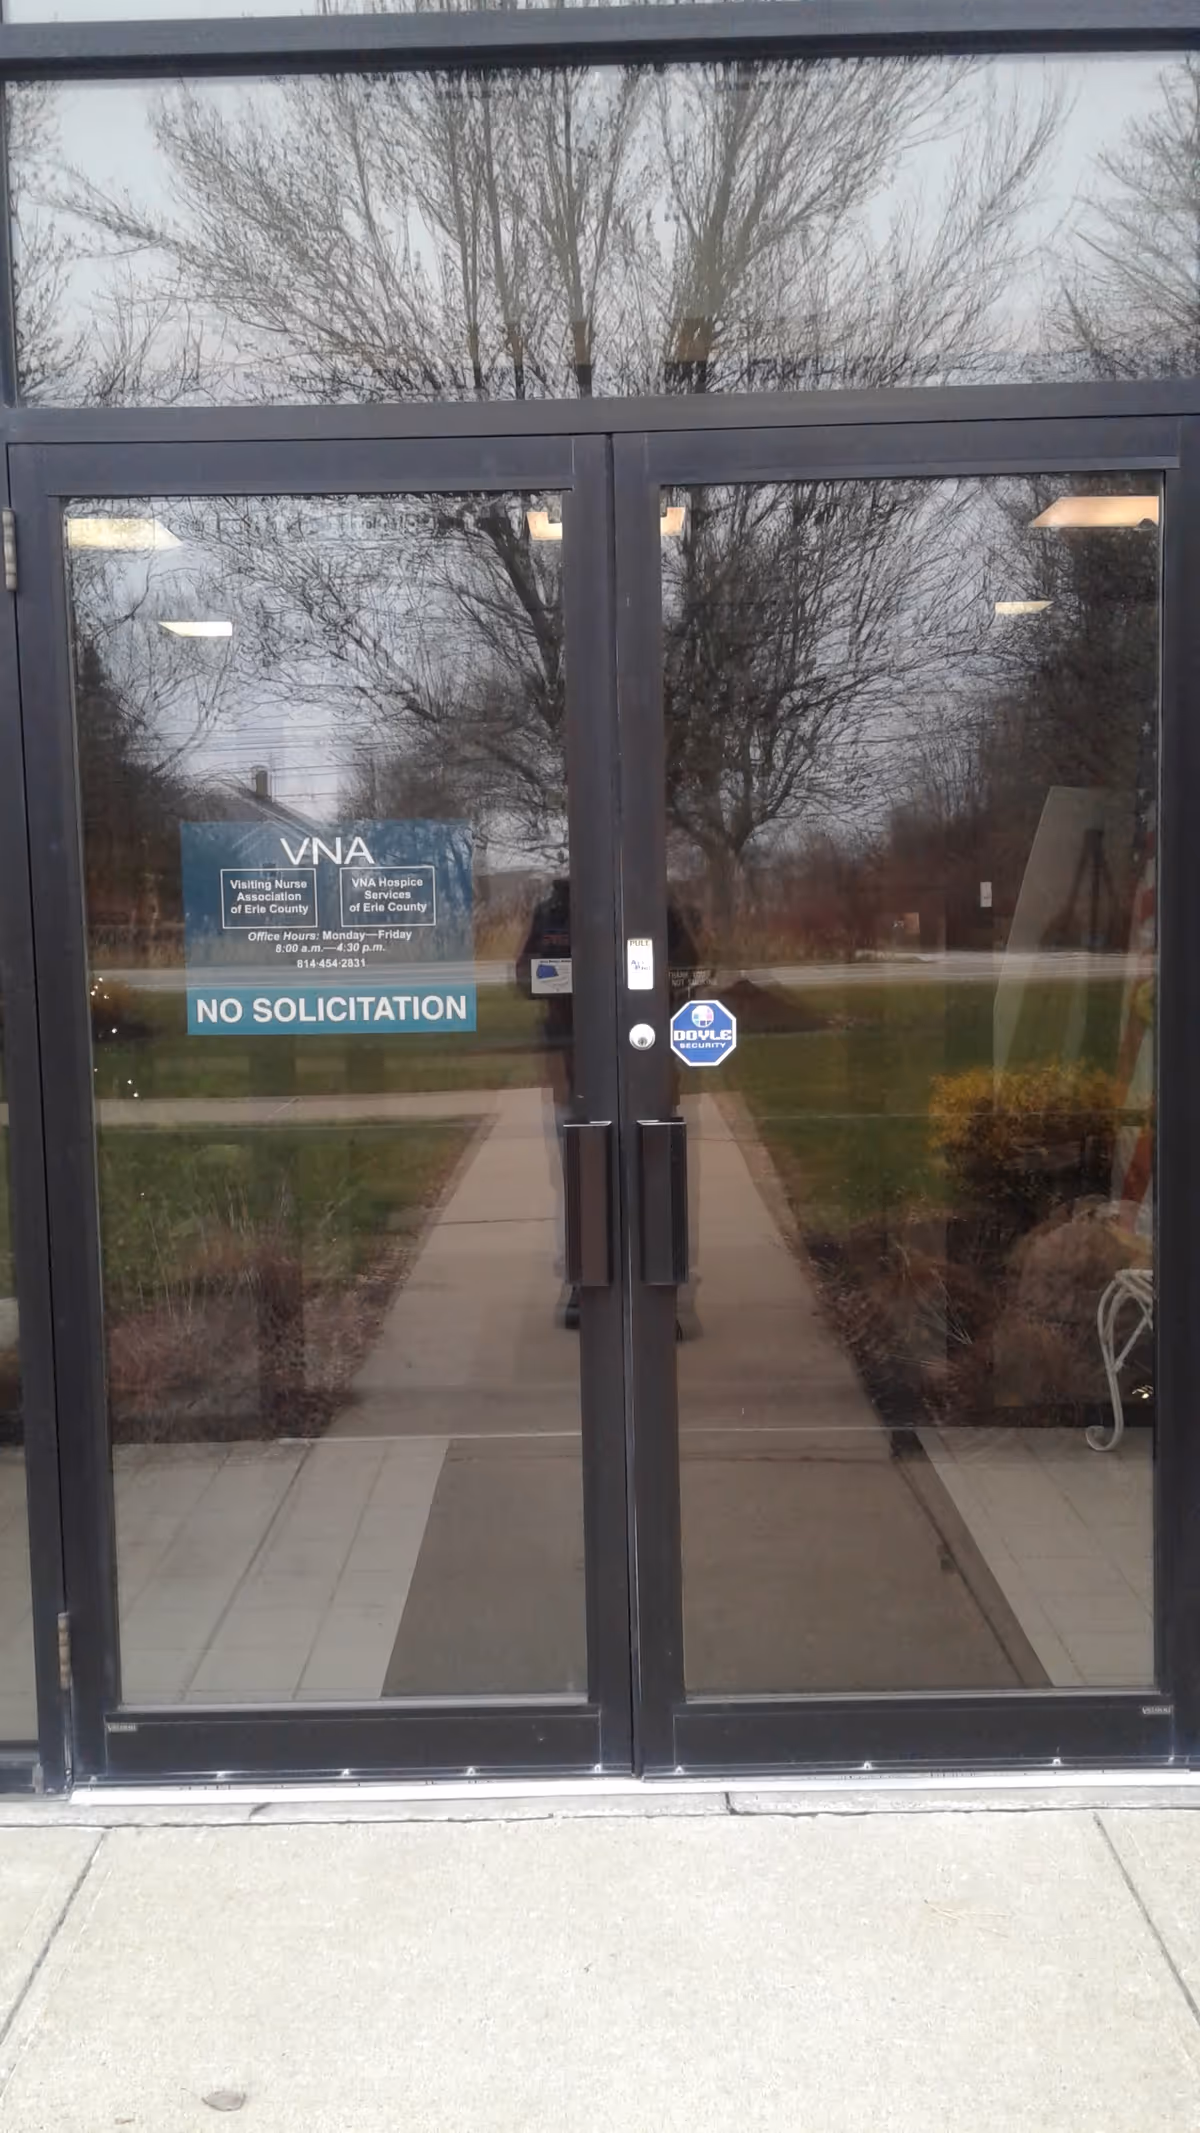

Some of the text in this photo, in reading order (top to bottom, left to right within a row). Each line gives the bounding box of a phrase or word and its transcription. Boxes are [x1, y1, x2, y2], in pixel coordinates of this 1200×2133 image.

[280, 836, 375, 866] VNA
[230, 880, 308, 891] Visiting Nurse
[351, 877, 424, 888] VNA Hospice
[236, 892, 302, 902] Association
[364, 890, 412, 900] Services
[230, 904, 309, 915] of Erie County
[349, 902, 428, 913] of Erie County
[247, 931, 280, 942] Office
[283, 931, 320, 941] Hours:
[275, 944, 299, 954] 8:00
[362, 944, 386, 954] p.m.
[196, 995, 467, 1024] NO SOLICITATION
[674, 1029, 733, 1041] DOYLE
